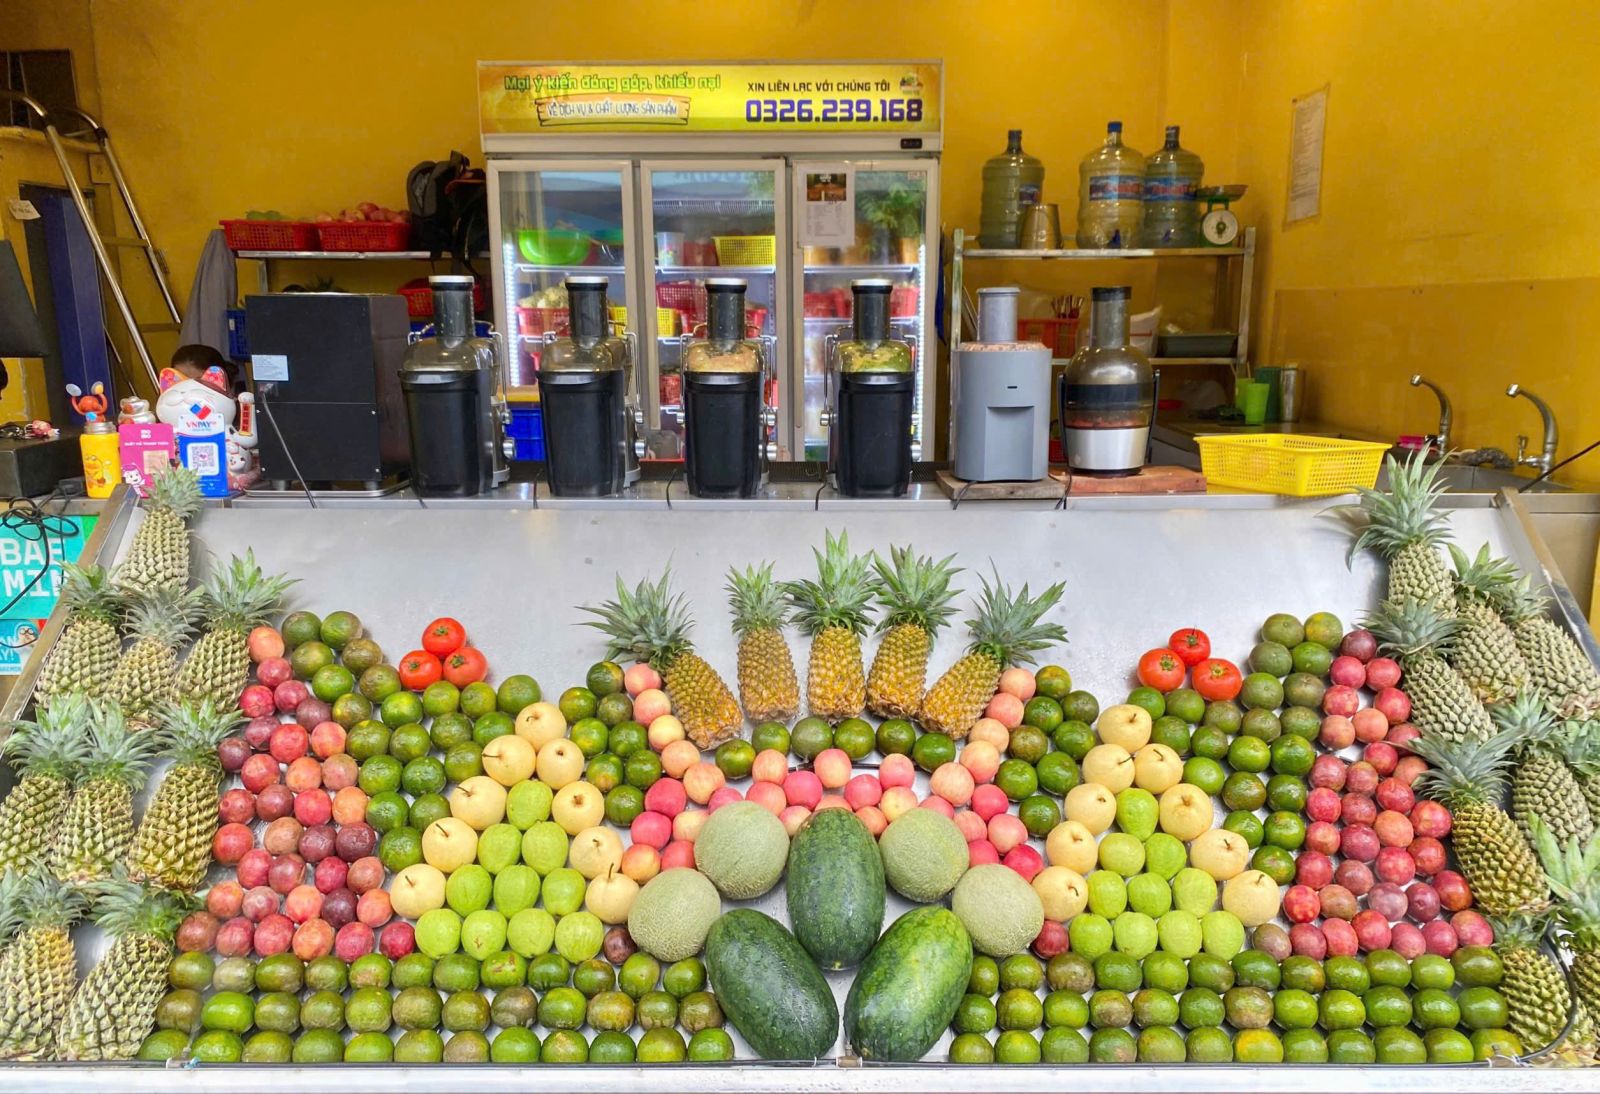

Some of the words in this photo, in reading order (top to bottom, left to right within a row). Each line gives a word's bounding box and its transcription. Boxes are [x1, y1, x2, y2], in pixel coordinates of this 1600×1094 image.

[504, 75, 530, 92] Mọi
[533, 74, 543, 92] ý
[546, 72, 578, 90] kiến
[581, 74, 617, 93] đóng
[655, 72, 695, 89] khiếu
[698, 74, 721, 91] nại
[748, 82, 765, 92] XIN
[768, 80, 790, 92] LIÊN
[793, 82, 812, 94] LẠC
[816, 79, 833, 92] VỚI
[836, 79, 871, 92] CHÚNG
[874, 79, 890, 92] TÔI
[746, 99, 923, 122] 0326.239.168
